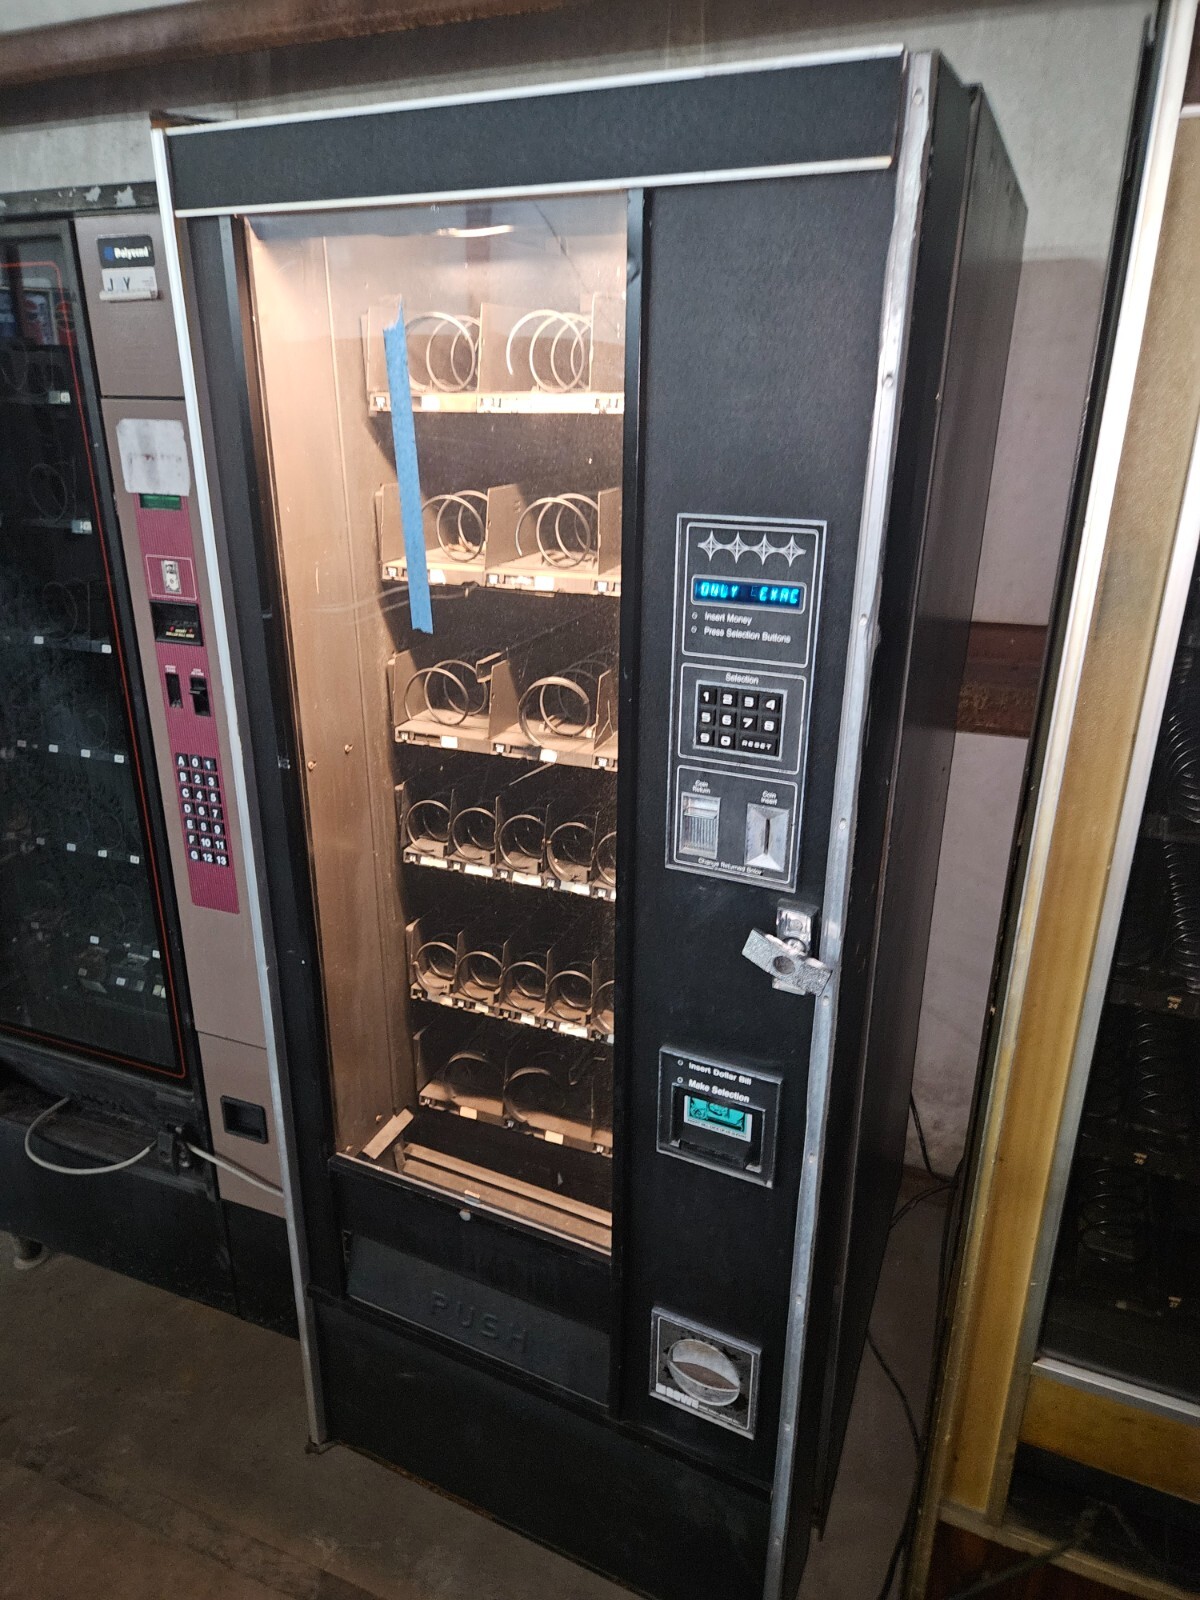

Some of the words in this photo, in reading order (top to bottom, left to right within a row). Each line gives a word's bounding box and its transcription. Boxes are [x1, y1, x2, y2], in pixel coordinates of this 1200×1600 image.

[704, 611, 725, 622] Insert
[727, 613, 752, 626] Money
[704, 626, 724, 637] Press
[726, 628, 760, 641] Selection
[762, 631, 791, 643] Buttons
[725, 672, 759, 685] Selection
[703, 691, 710, 702] 1
[722, 693, 733, 705] 2
[744, 696, 754, 708] 3
[765, 699, 776, 711] 4
[701, 712, 711, 723] 5
[722, 714, 732, 726] 6
[742, 717, 753, 728] 7
[720, 735, 731, 746] 0
[178, 756, 185, 766] A
[205, 760, 211, 770] 1
[179, 772, 187, 782] B
[194, 774, 201, 783] 2
[208, 777, 215, 786] 3
[182, 788, 190, 798] C
[196, 790, 203, 800] 4
[210, 793, 217, 802] 5
[183, 803, 191, 813] D
[198, 806, 205, 816] 6
[212, 809, 218, 818] 7
[186, 819, 194, 829] E
[200, 822, 207, 831] 8
[214, 824, 221, 834] 9
[188, 835, 195, 844] F
[201, 837, 211, 847] 10
[215, 840, 224, 850] 11
[190, 850, 198, 860] G
[202, 853, 213, 863] 12
[216, 855, 227, 866] 13
[689, 1062, 711, 1074] Insert
[713, 1069, 737, 1081] Dollar
[739, 1075, 752, 1086] Bill
[688, 1079, 710, 1092] Make
[711, 1085, 750, 1103] Selection
[431, 1289, 528, 1351] PUSH
